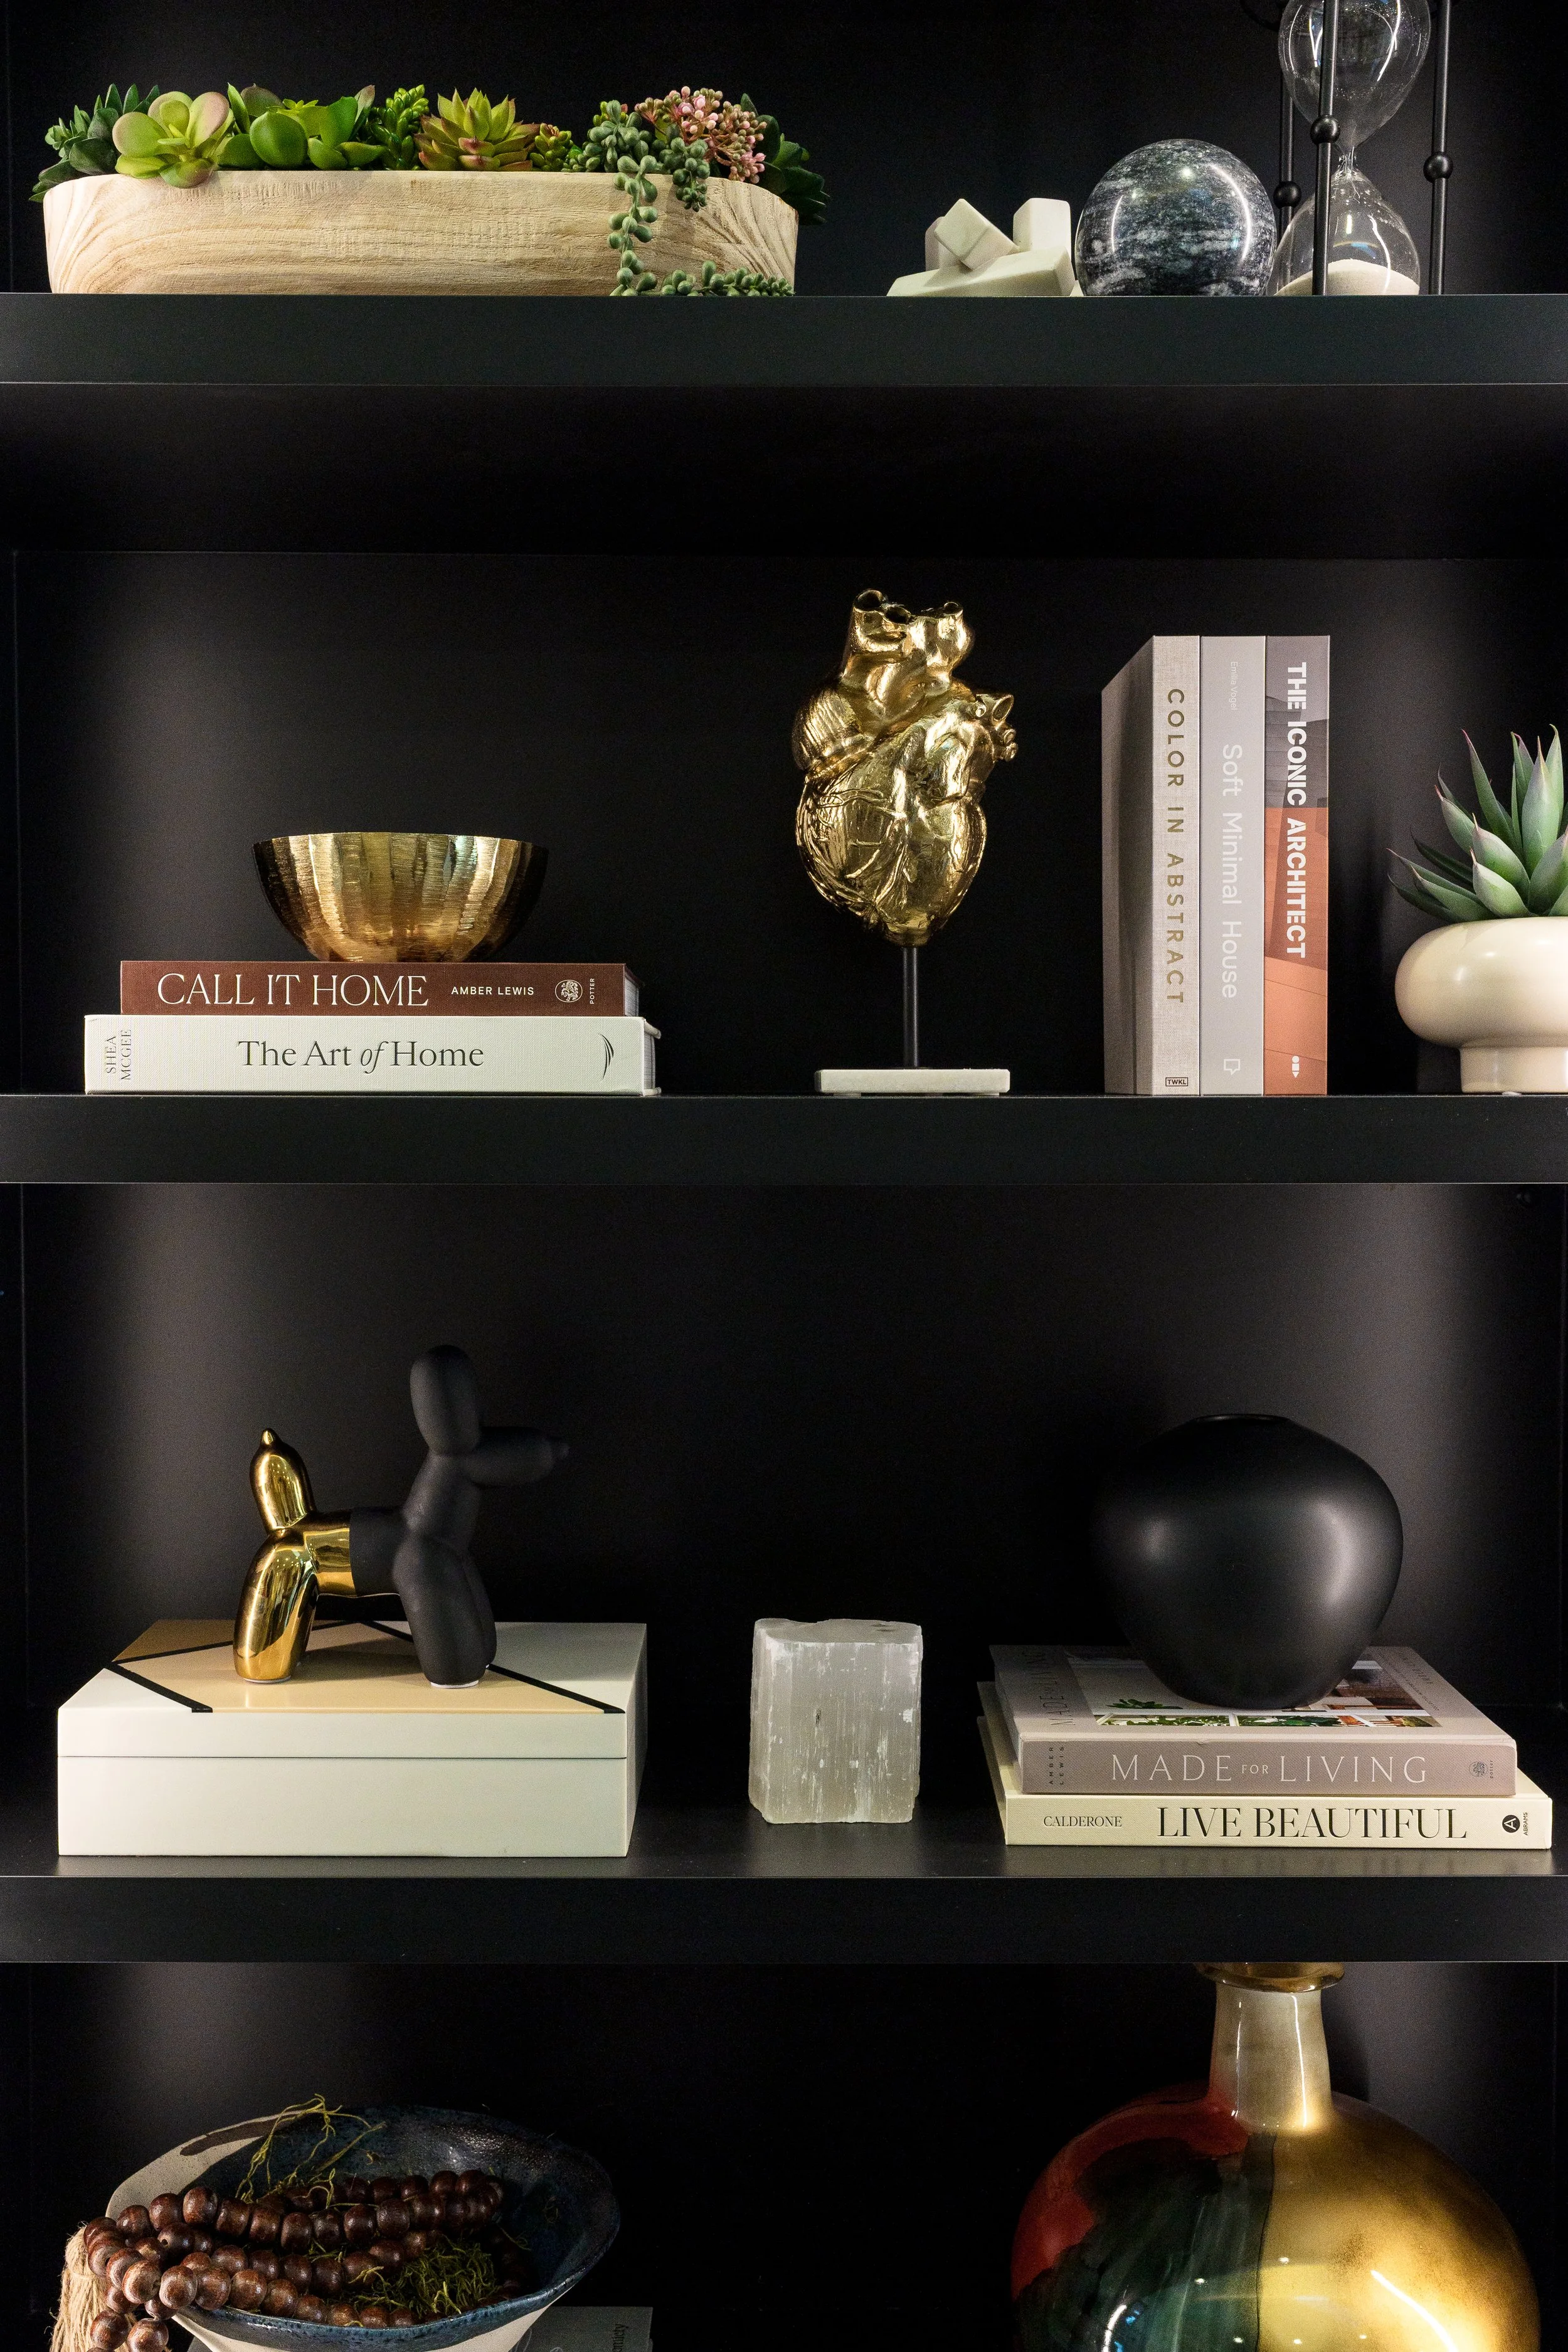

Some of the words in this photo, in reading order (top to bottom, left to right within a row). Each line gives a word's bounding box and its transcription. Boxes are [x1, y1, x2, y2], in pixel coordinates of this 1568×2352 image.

[1230, 661, 1239, 685] Emilia
[1288, 662, 1306, 709] THE
[1228, 686, 1239, 711] Vogel
[1168, 689, 1184, 786] COLOR
[1223, 744, 1243, 796] Soft
[1288, 721, 1306, 805] ICONIC
[1168, 807, 1184, 832] IN
[1223, 813, 1242, 903] Minimal
[1287, 818, 1306, 958] ARCHITECT
[1167, 853, 1184, 1002] ABSTRACT
[1222, 921, 1241, 997] House
[158, 973, 254, 1004] CALL
[268, 975, 300, 1005] IT
[313, 975, 428, 1005] HOME
[452, 987, 492, 995] AMBER
[105, 1036, 117, 1074] SHEA
[120, 1029, 132, 1080] MCGEE
[238, 1041, 296, 1066] The
[304, 1041, 351, 1066] Art
[361, 1041, 388, 1074] of
[392, 1042, 483, 1066] Home
[1113, 1755, 1231, 1781] MADE
[1242, 1765, 1268, 1774] FOR
[1281, 1756, 1426, 1783] LIVING
[1044, 1816, 1121, 1826] CALDERONE
[1158, 1808, 1242, 1838] LIVE
[1255, 1808, 1466, 1838] BEAUTIFUL
